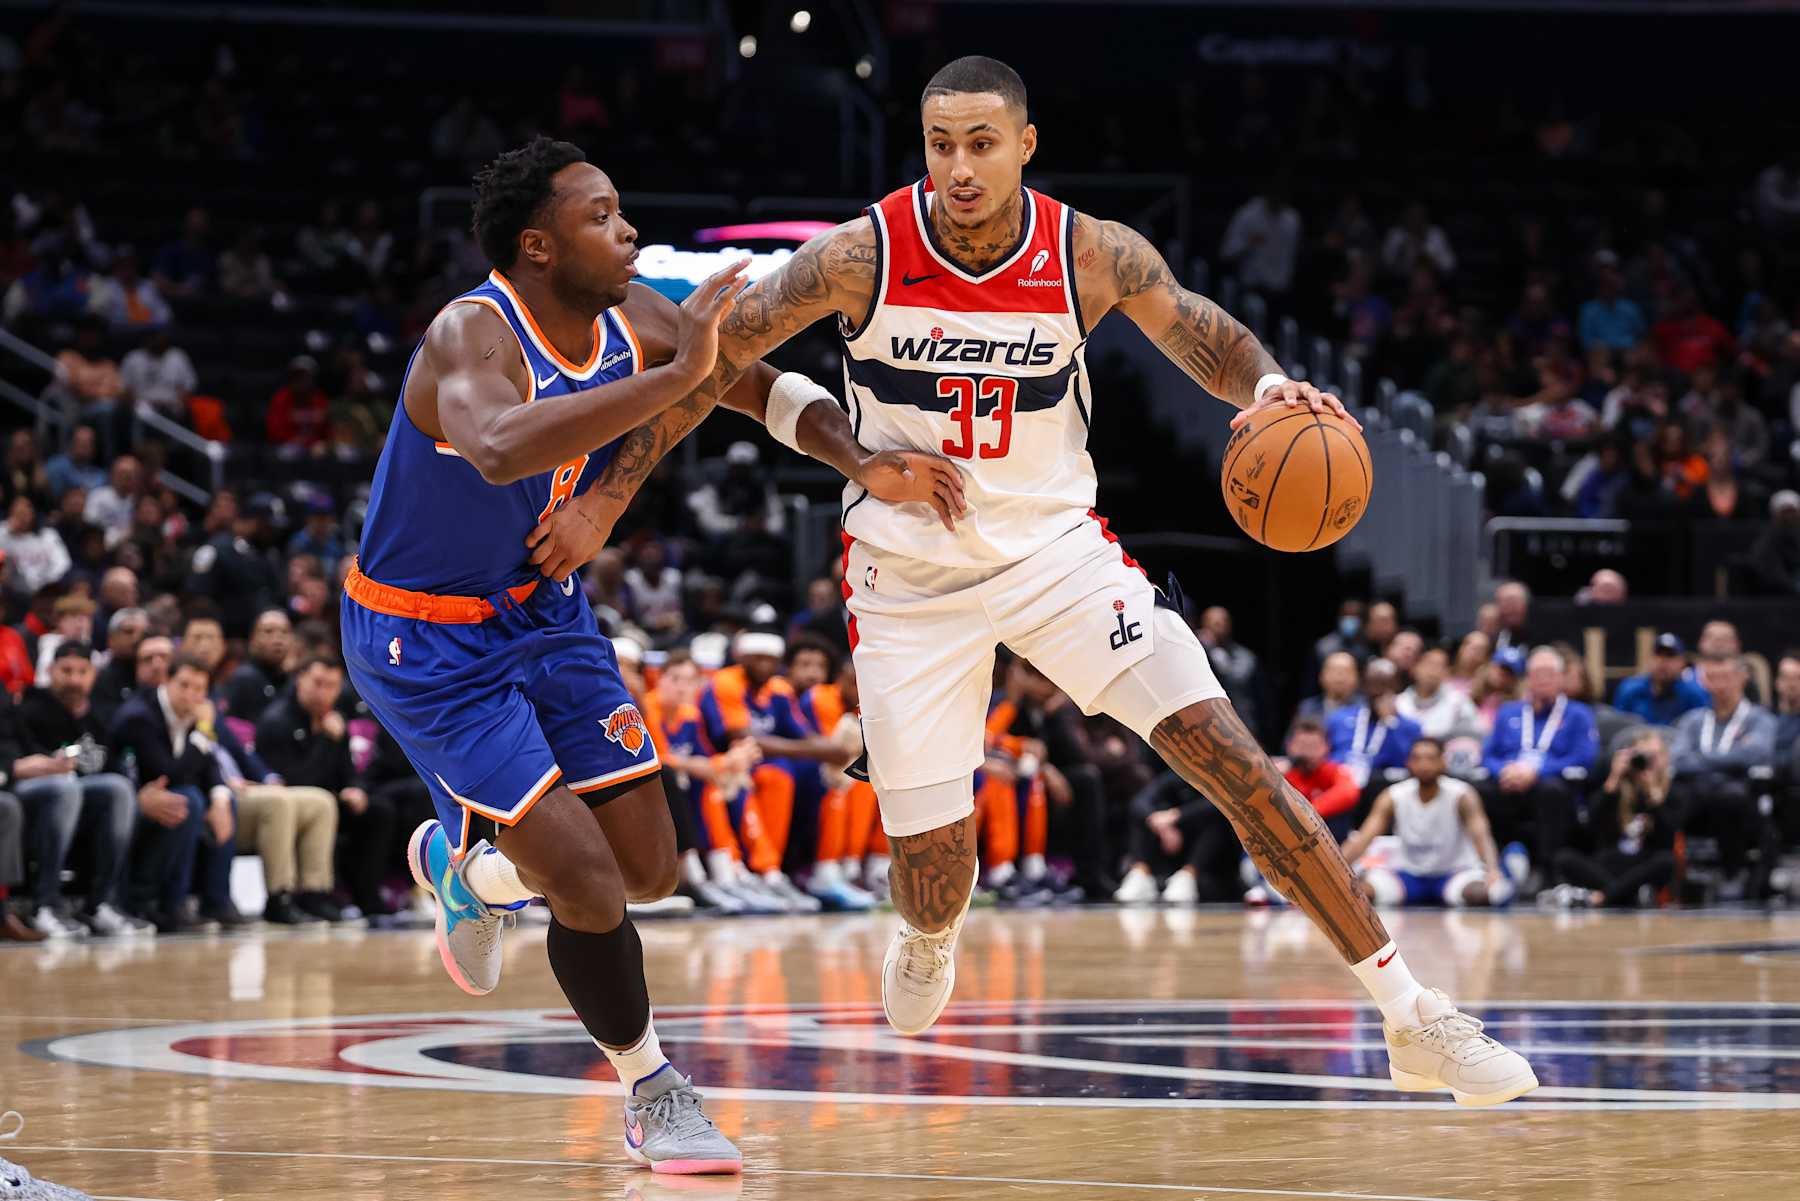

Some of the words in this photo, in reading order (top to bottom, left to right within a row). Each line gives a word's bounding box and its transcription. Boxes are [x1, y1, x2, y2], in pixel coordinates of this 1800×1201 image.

[1017, 278, 1062, 287] Robinhood
[891, 327, 1059, 366] wizards
[936, 376, 1019, 461] 33
[536, 453, 590, 523] 8
[1109, 611, 1143, 651] dc
